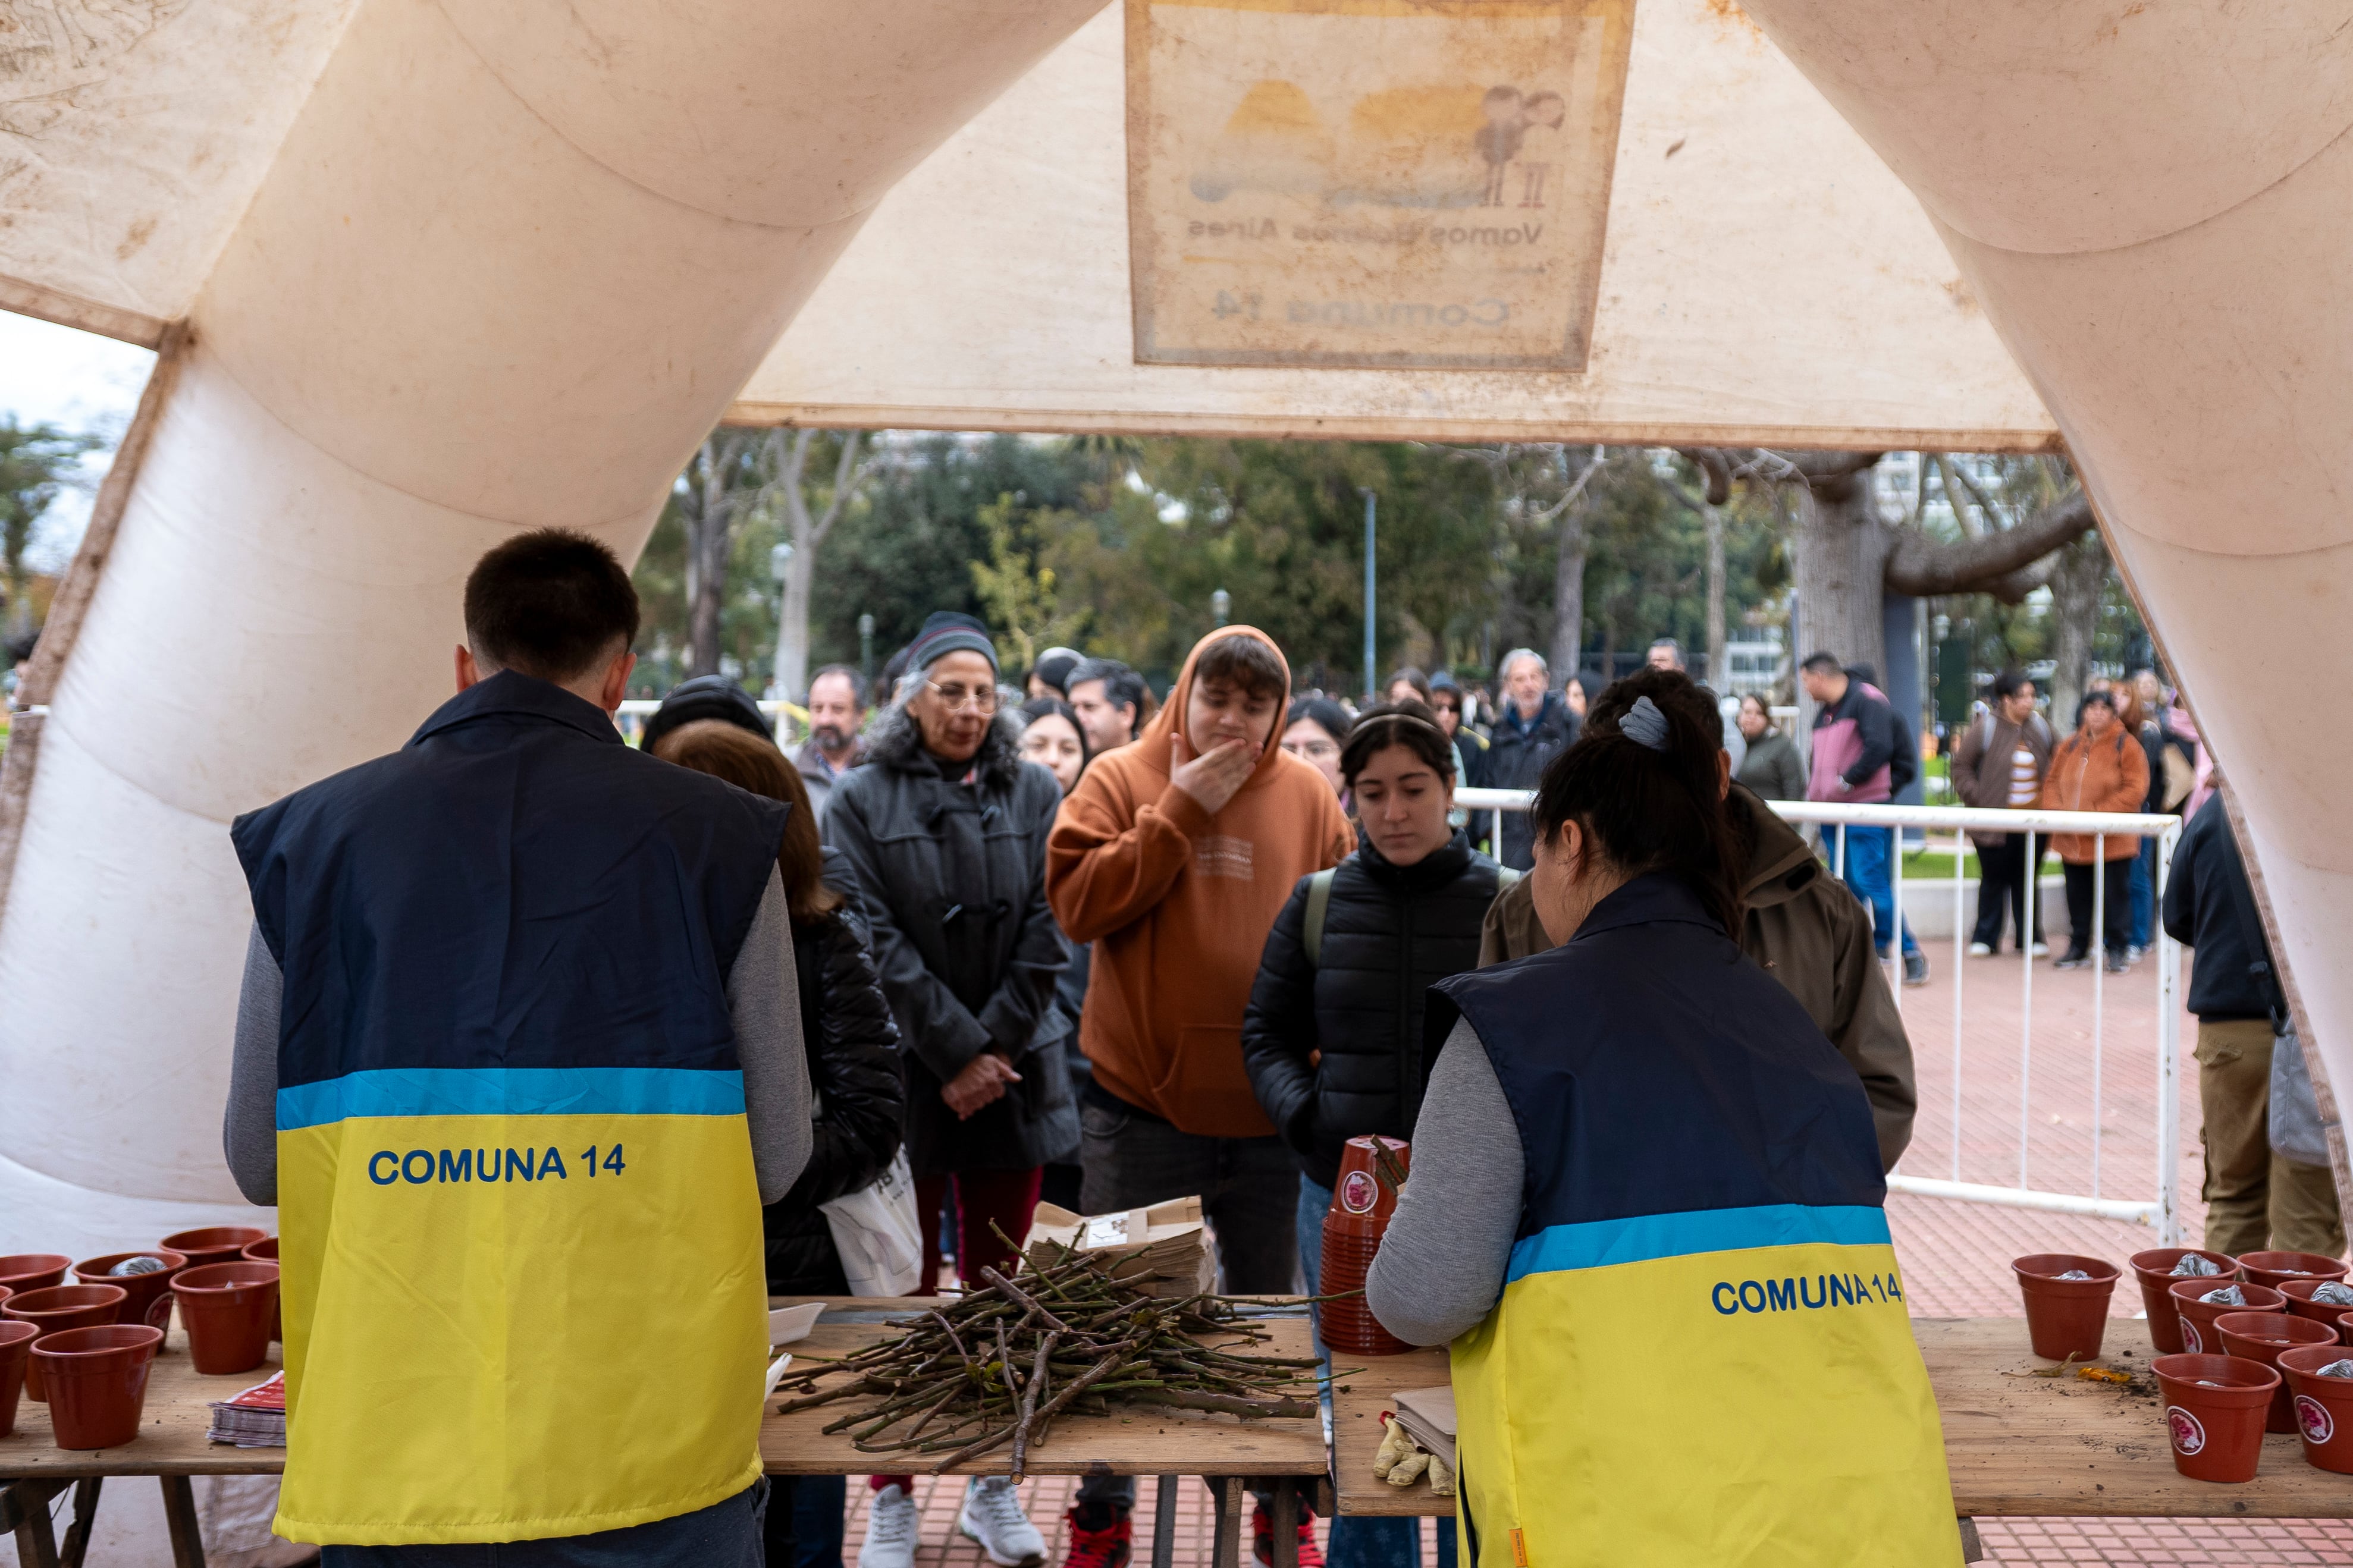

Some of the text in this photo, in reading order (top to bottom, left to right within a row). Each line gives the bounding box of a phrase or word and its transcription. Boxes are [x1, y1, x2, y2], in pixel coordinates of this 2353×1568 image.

[368, 1143, 626, 1185] COMUNA 14
[1712, 1272, 1902, 1315] COMUNA 14
